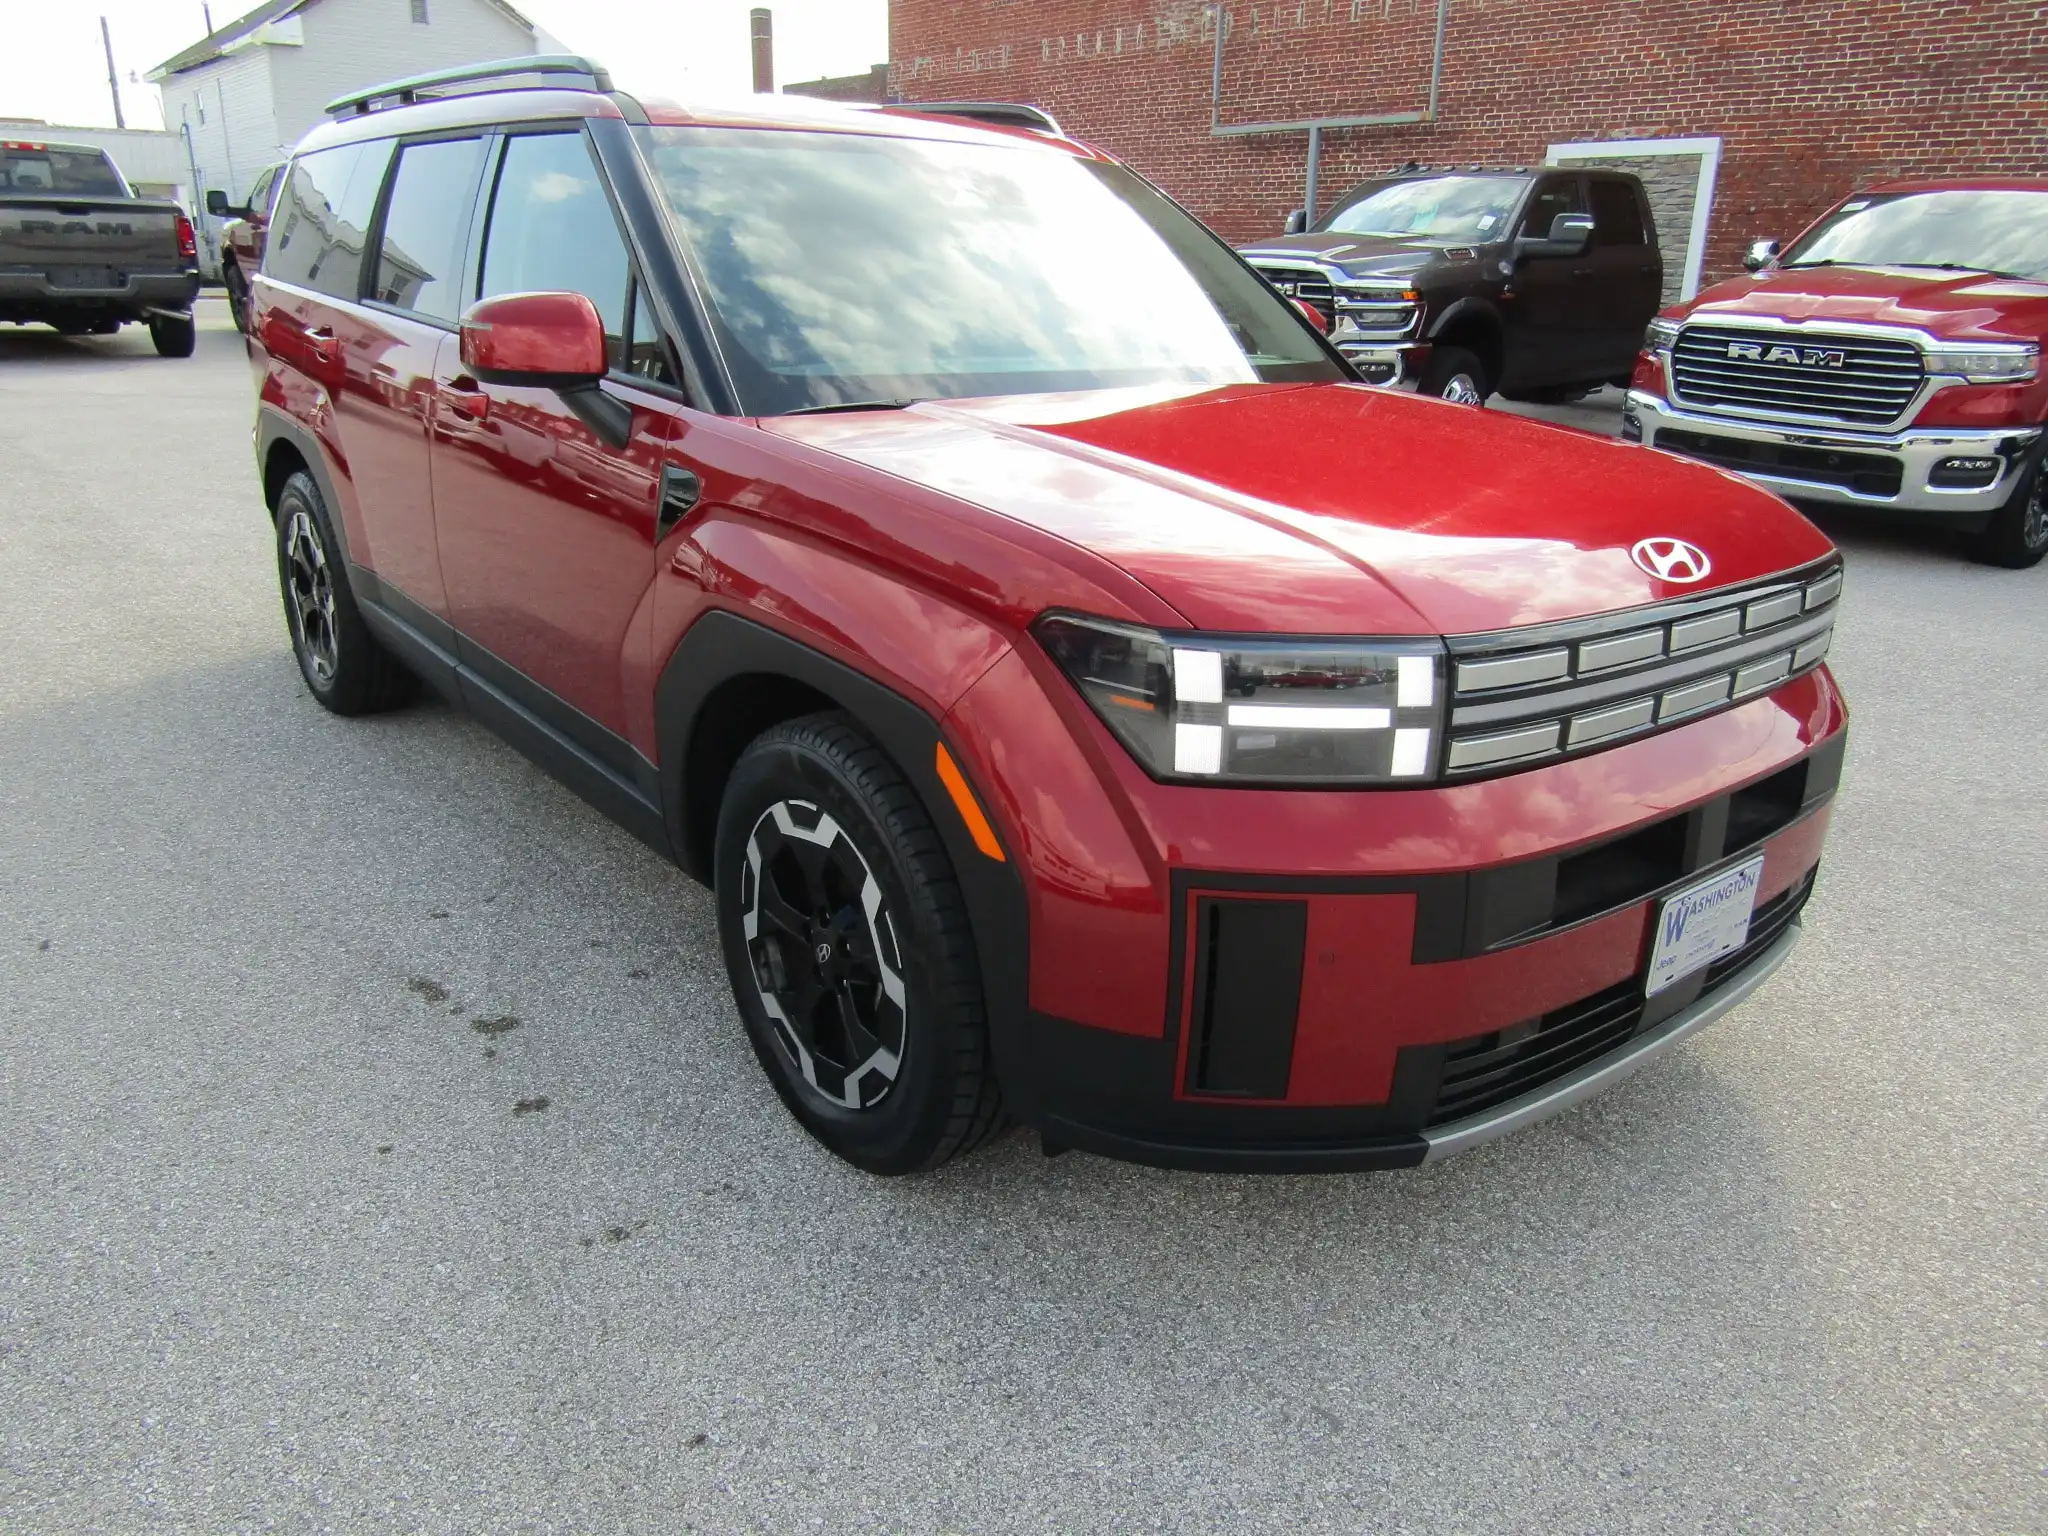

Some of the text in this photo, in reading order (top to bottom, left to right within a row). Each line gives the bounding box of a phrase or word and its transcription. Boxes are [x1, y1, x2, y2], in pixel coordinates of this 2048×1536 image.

[20, 219, 133, 236] RAM
[1727, 342, 1845, 368] RAM
[1665, 871, 1756, 947] WASHINGTON
